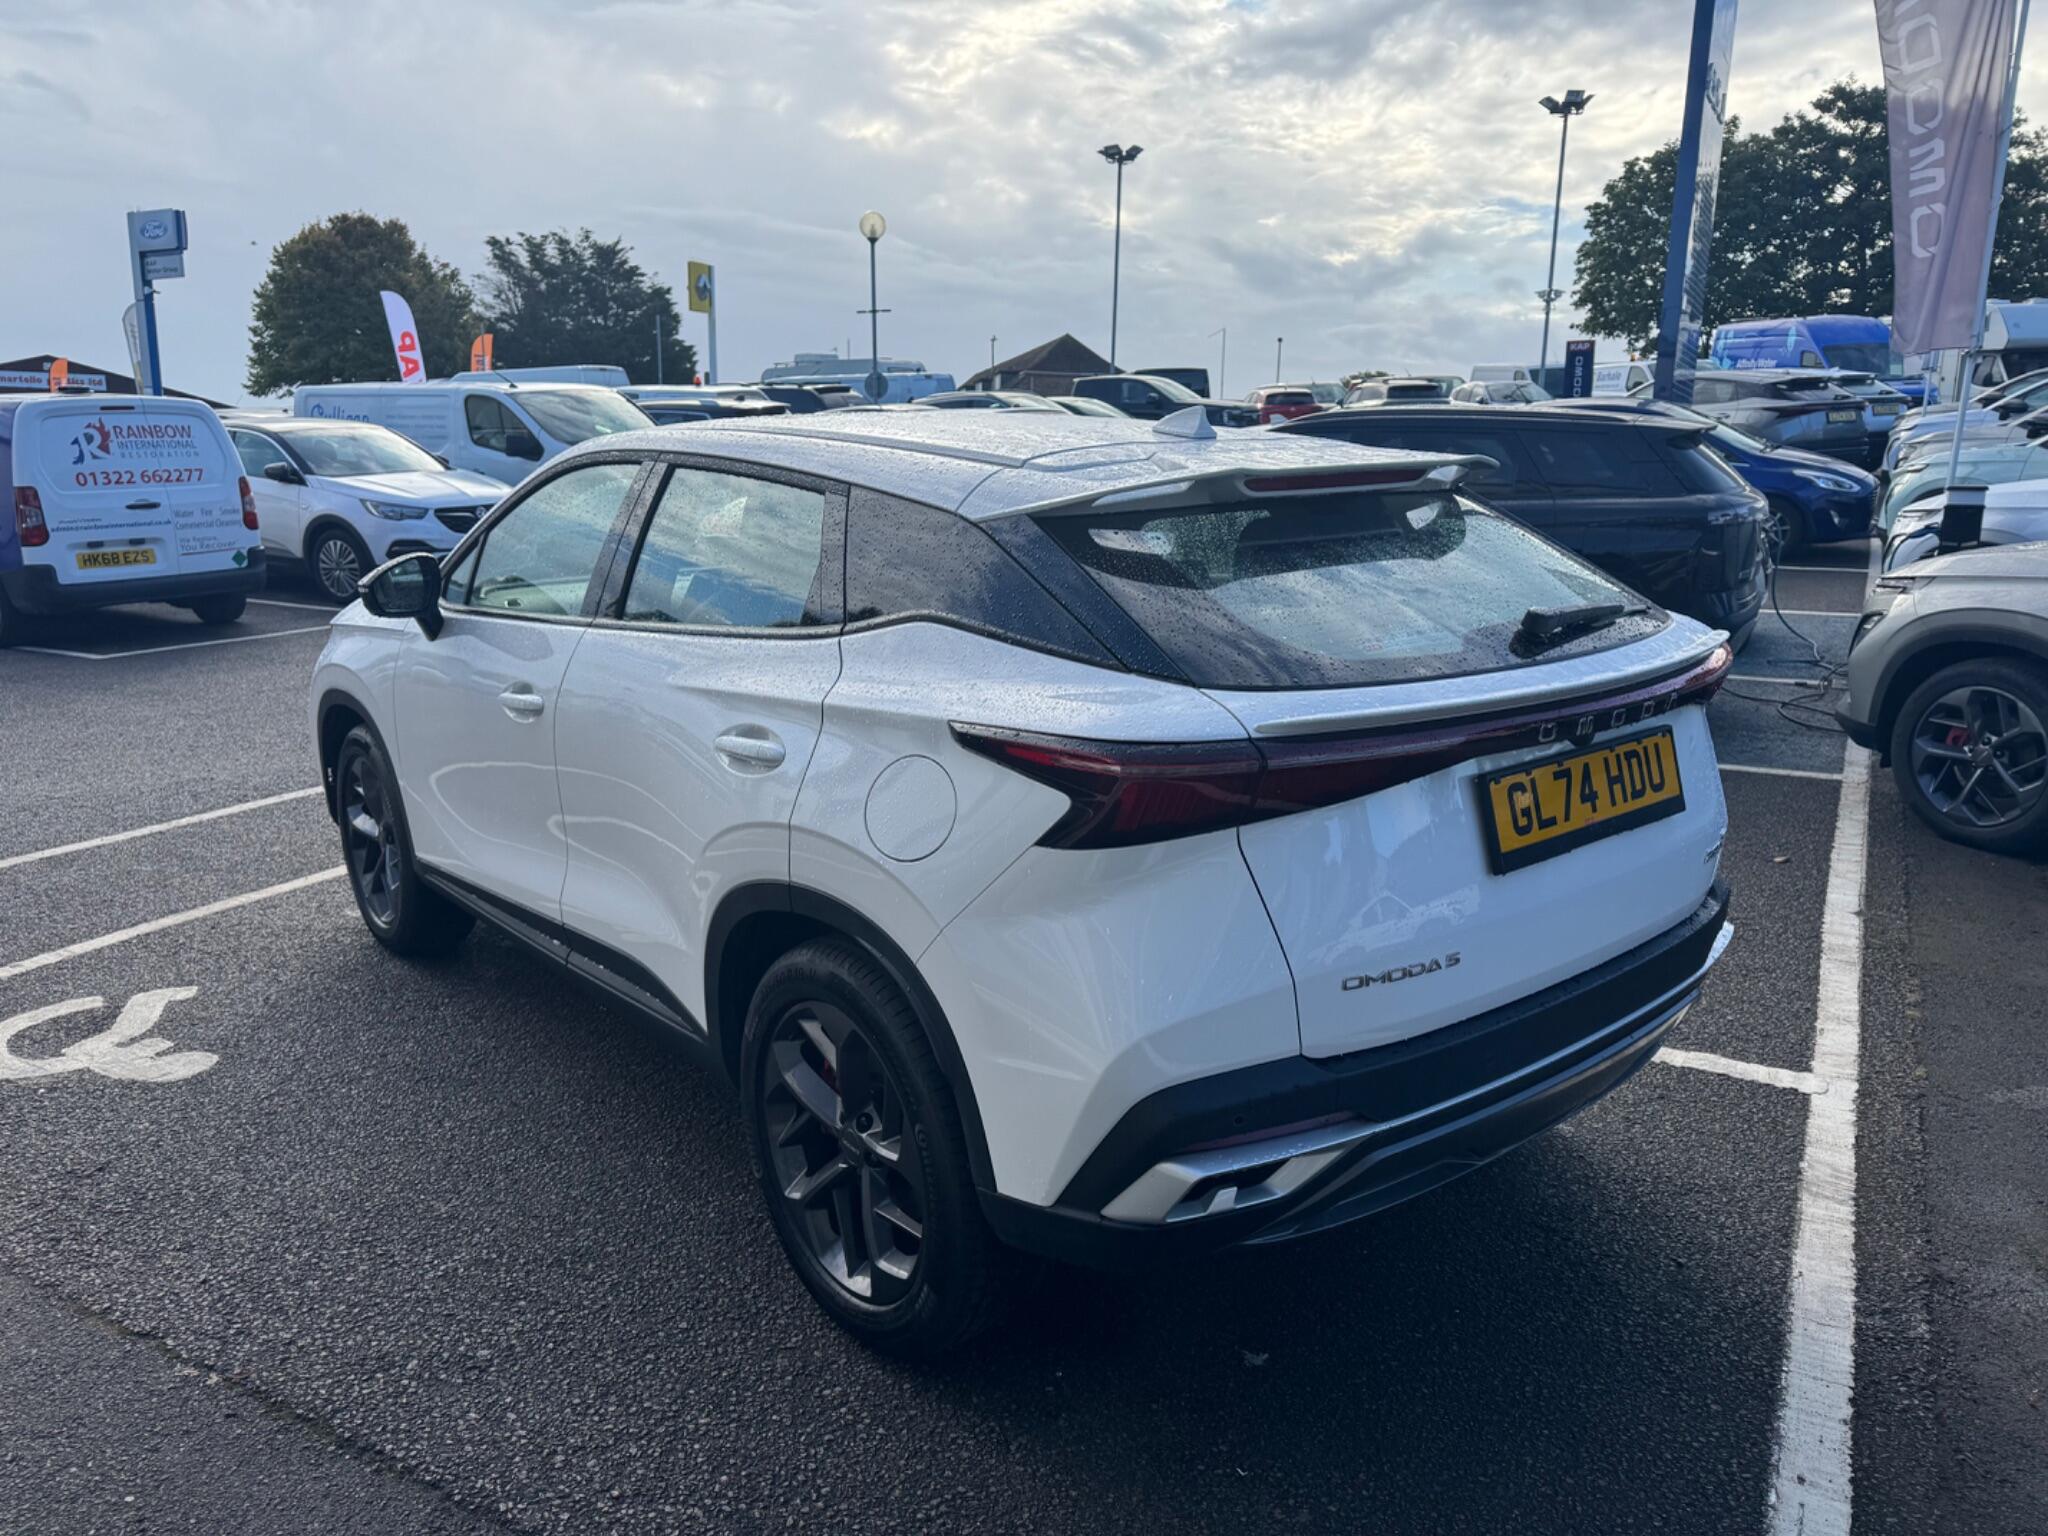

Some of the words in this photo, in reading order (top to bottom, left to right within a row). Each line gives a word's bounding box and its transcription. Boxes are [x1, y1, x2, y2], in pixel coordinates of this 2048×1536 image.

[1569, 342, 1590, 351] KAP
[112, 424, 192, 440] RAINBOW
[116, 439, 197, 450] INTERNATIONAL
[120, 450, 200, 460] RESTORATION
[75, 469, 137, 487] 01322
[140, 467, 204, 484] 662277
[82, 551, 121, 568] HK68
[1507, 760, 1599, 837] GL74
[1603, 741, 1666, 807] HDU
[1341, 957, 1442, 991] OMODA
[1444, 951, 1461, 969] 5
